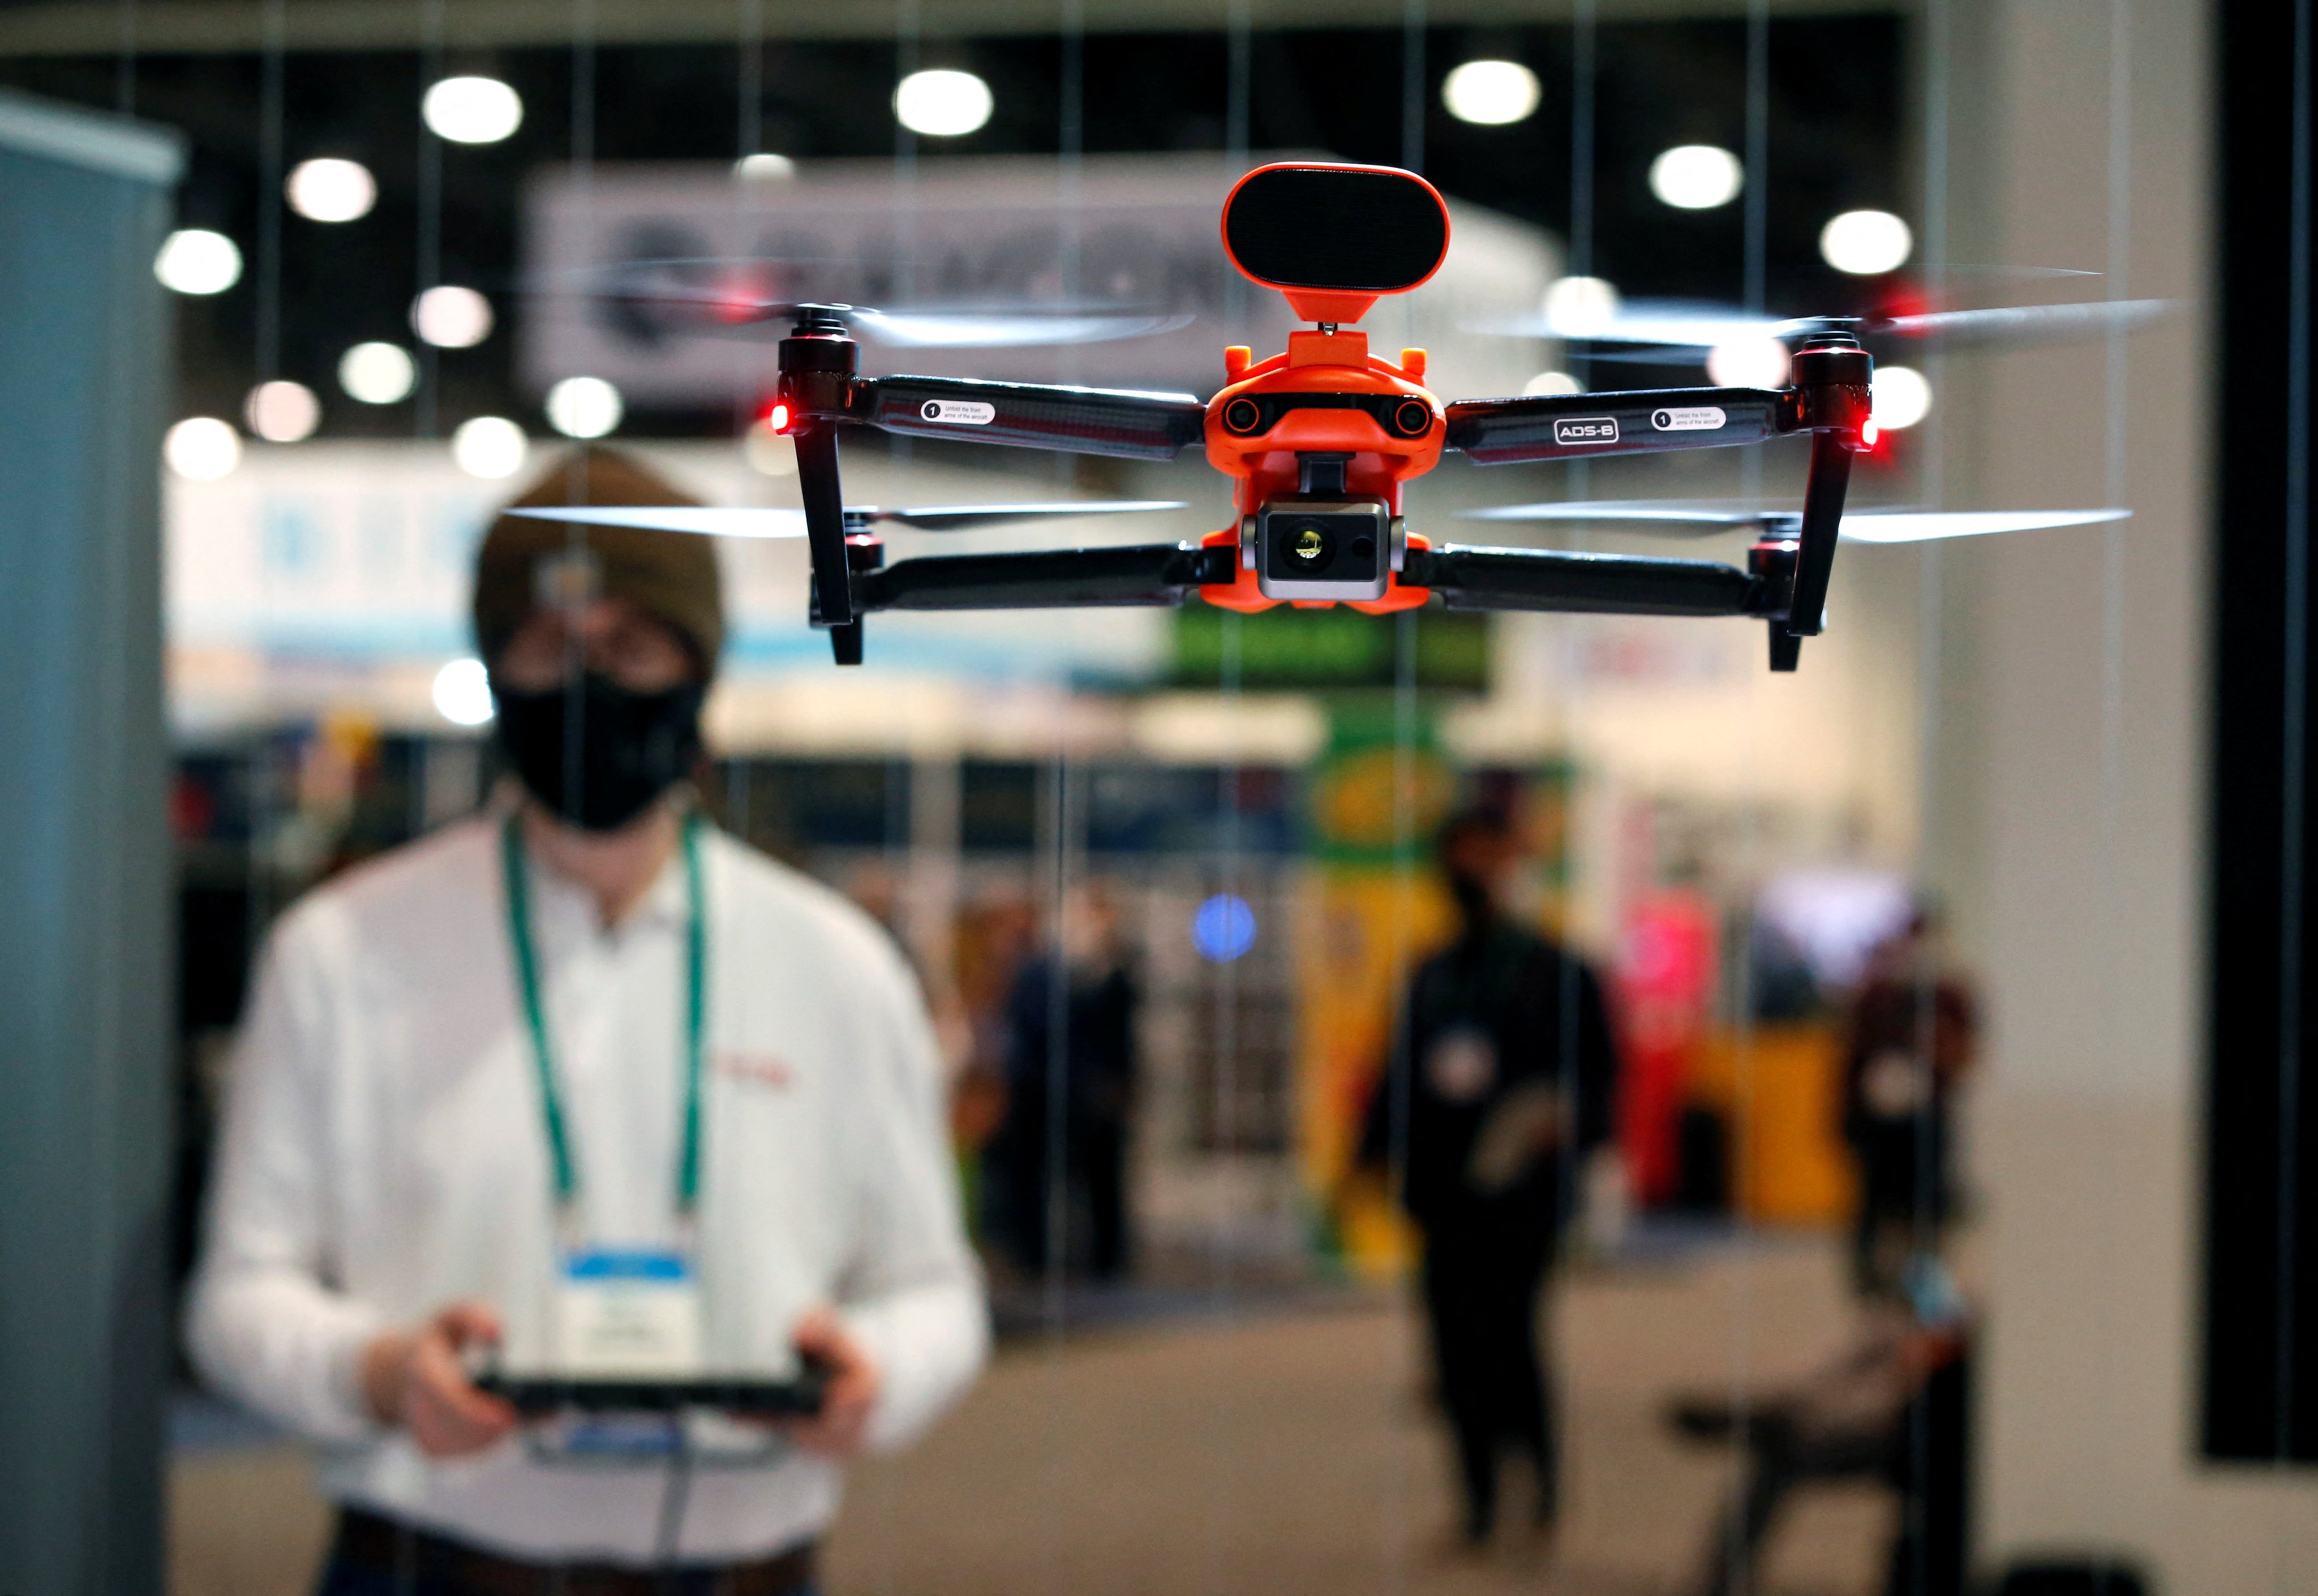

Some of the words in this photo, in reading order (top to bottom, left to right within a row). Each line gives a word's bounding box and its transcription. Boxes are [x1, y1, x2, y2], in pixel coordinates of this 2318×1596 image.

[930, 406, 935, 416] 1
[1660, 415, 1666, 424] 1
[1560, 425, 1614, 437] ADS-B
